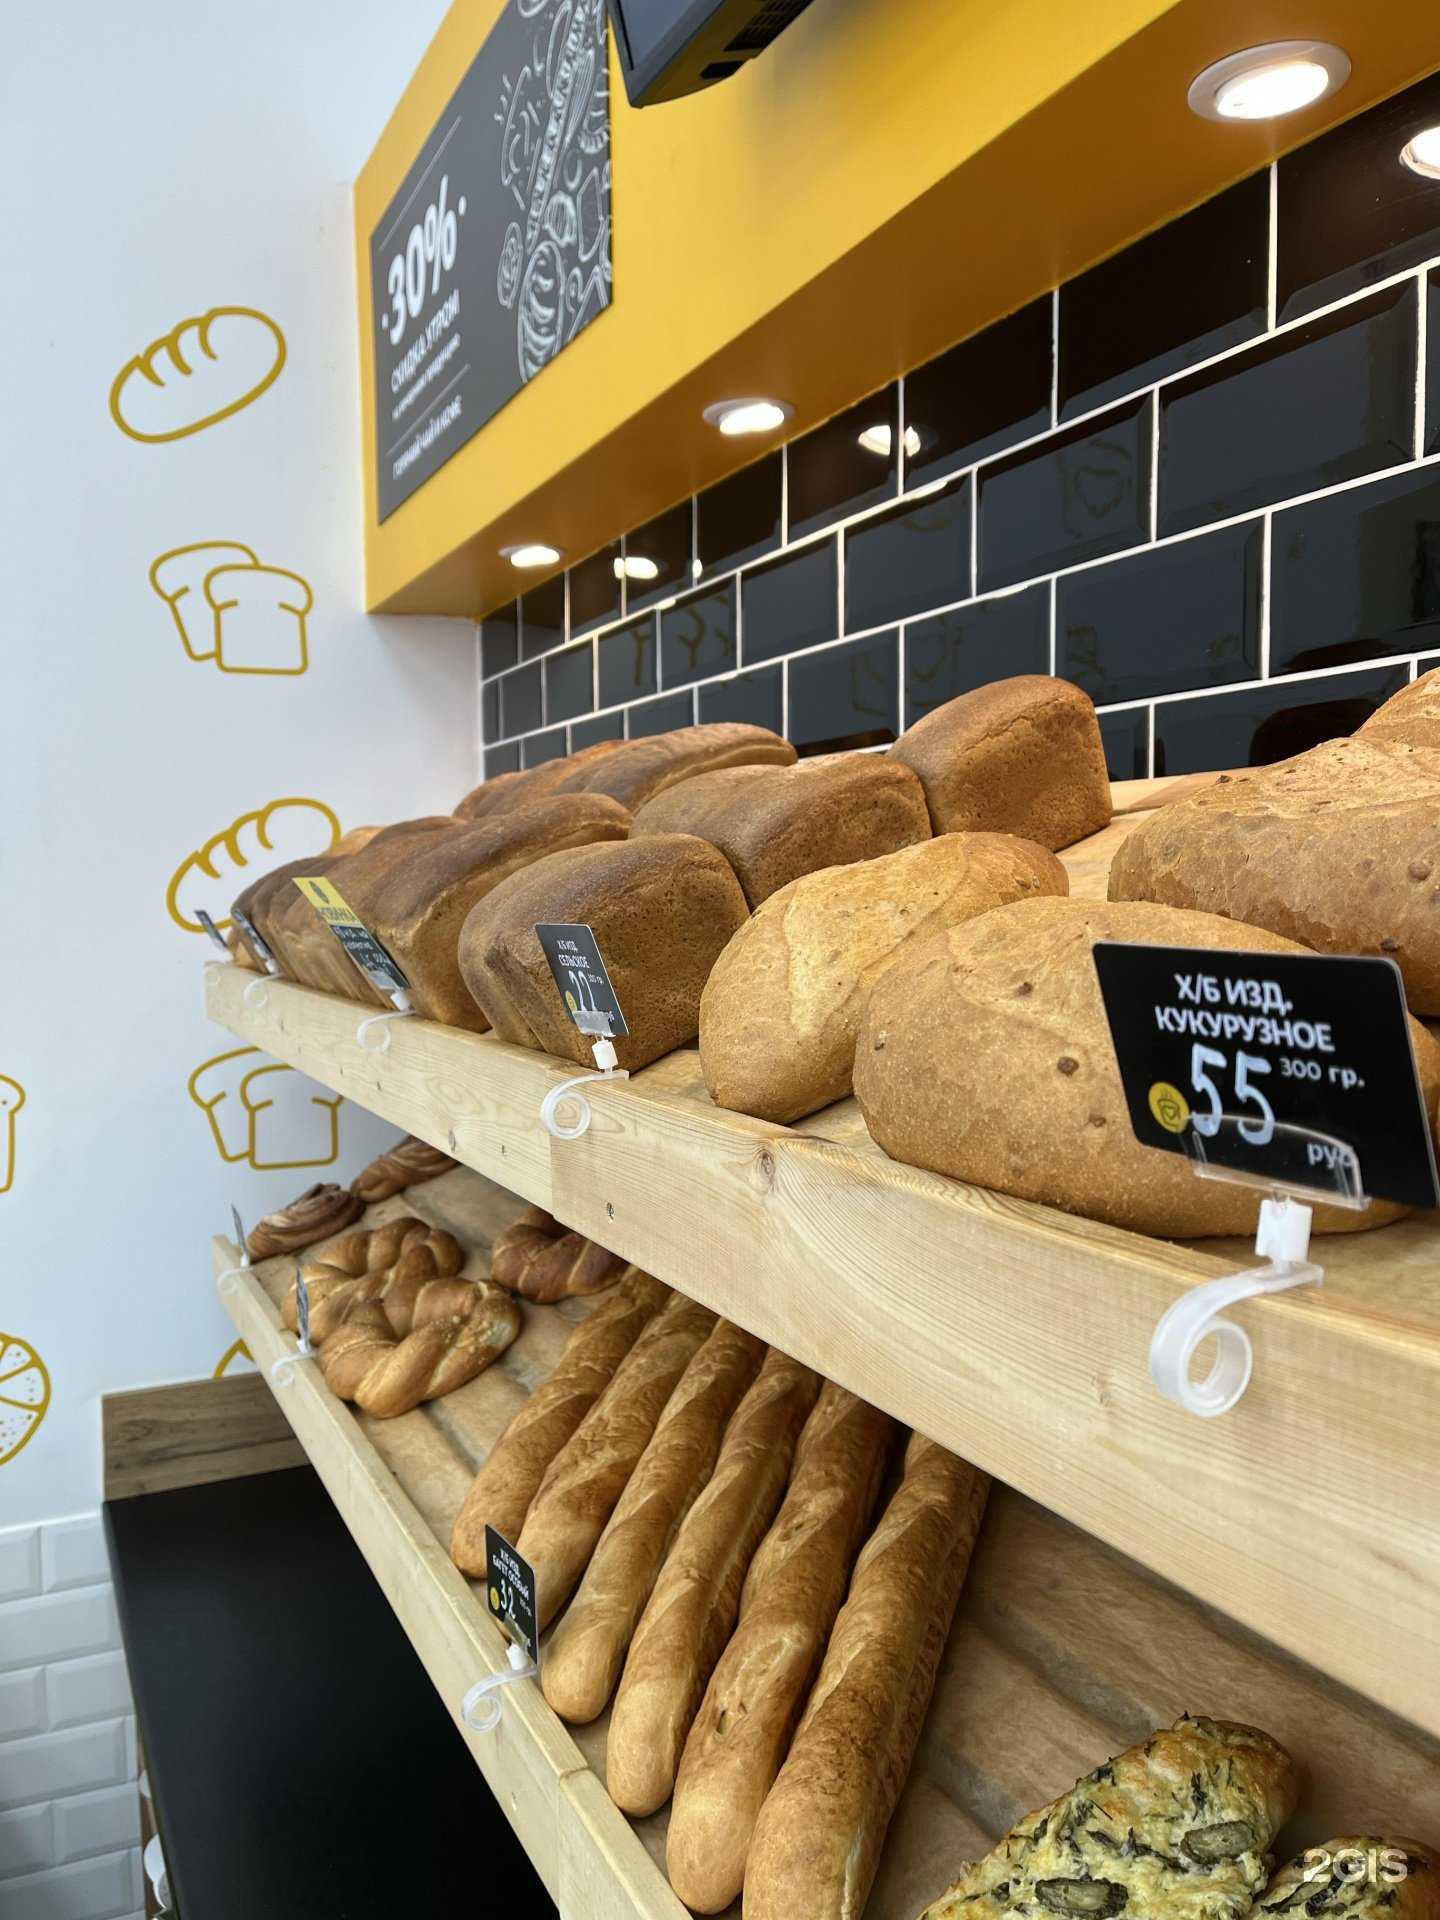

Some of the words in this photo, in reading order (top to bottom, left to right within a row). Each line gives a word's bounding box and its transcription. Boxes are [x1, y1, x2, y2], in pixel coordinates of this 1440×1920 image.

[1173, 972, 1221, 1004] Х/Б
[1224, 977, 1294, 1017] ИЗД.
[1154, 1005, 1336, 1053] КУКУРУЗНОЕ
[1191, 1042, 1276, 1146] 55
[1278, 1057, 1322, 1080] 300
[1328, 1067, 1366, 1091] гр.
